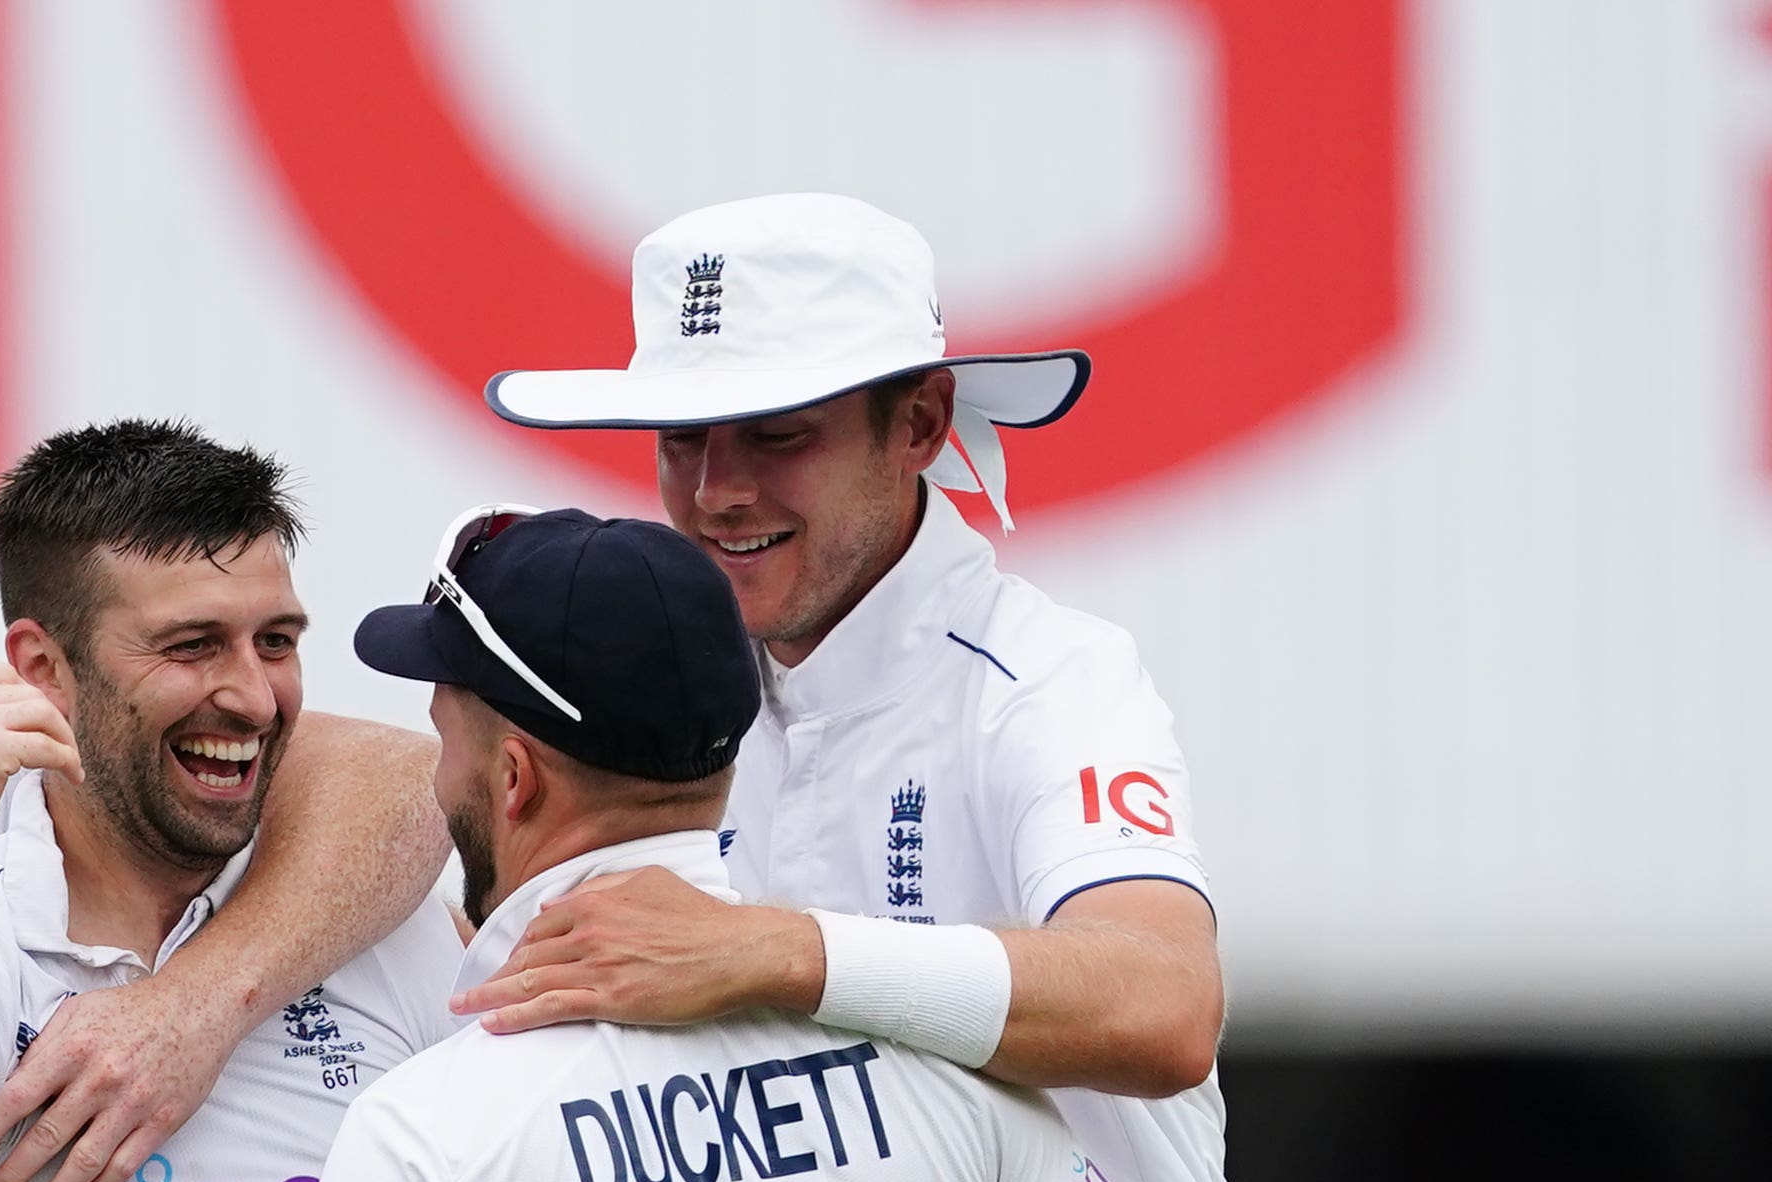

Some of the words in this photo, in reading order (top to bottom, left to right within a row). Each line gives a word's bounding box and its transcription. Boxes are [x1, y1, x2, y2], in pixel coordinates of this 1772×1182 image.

[1079, 766, 1175, 837] IG
[284, 1043, 326, 1059] ASHES
[319, 1054, 347, 1067] 2023
[322, 1064, 358, 1090] 667
